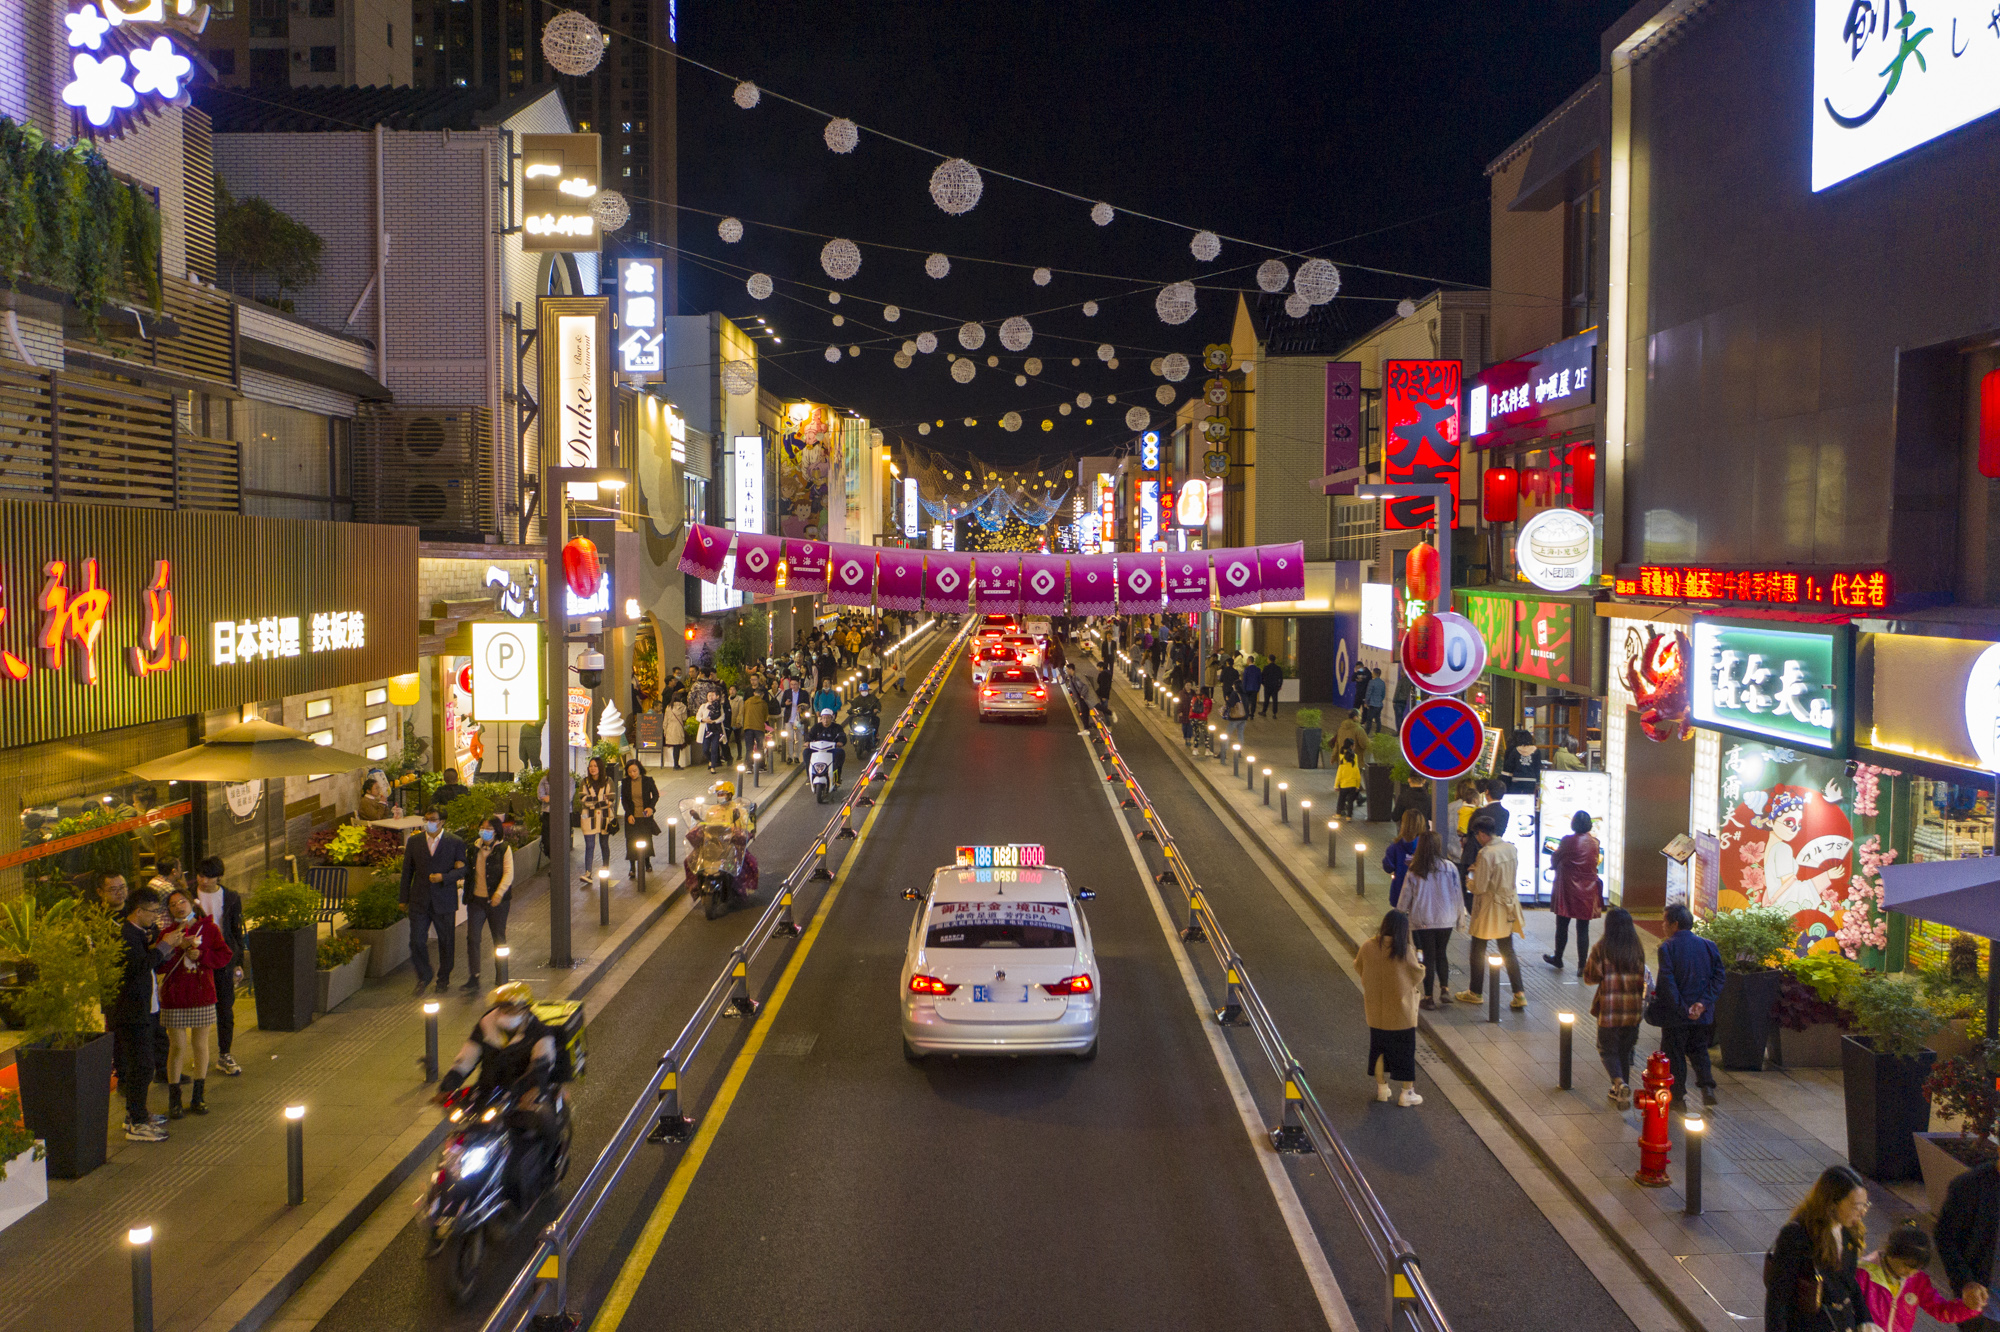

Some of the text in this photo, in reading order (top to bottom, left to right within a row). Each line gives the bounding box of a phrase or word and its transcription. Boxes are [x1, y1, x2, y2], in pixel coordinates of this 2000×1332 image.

[583, 335, 591, 386] Restaurant
[1390, 363, 1459, 403] やきとり
[1490, 382, 1530, 418] 日式料理
[1574, 366, 1588, 390] 2F
[566, 384, 592, 468] Duke
[1387, 402, 1460, 527] 大吉
[788, 556, 826, 566] 淮海街
[978, 579, 1016, 588] 淮海街
[1168, 577, 1207, 587] 淮海街
[214, 616, 301, 666] 日本料理
[500, 642, 514, 669] P
[975, 846, 992, 867] 186
[993, 846, 1018, 867] 0620
[1020, 846, 1045, 867] 0000
